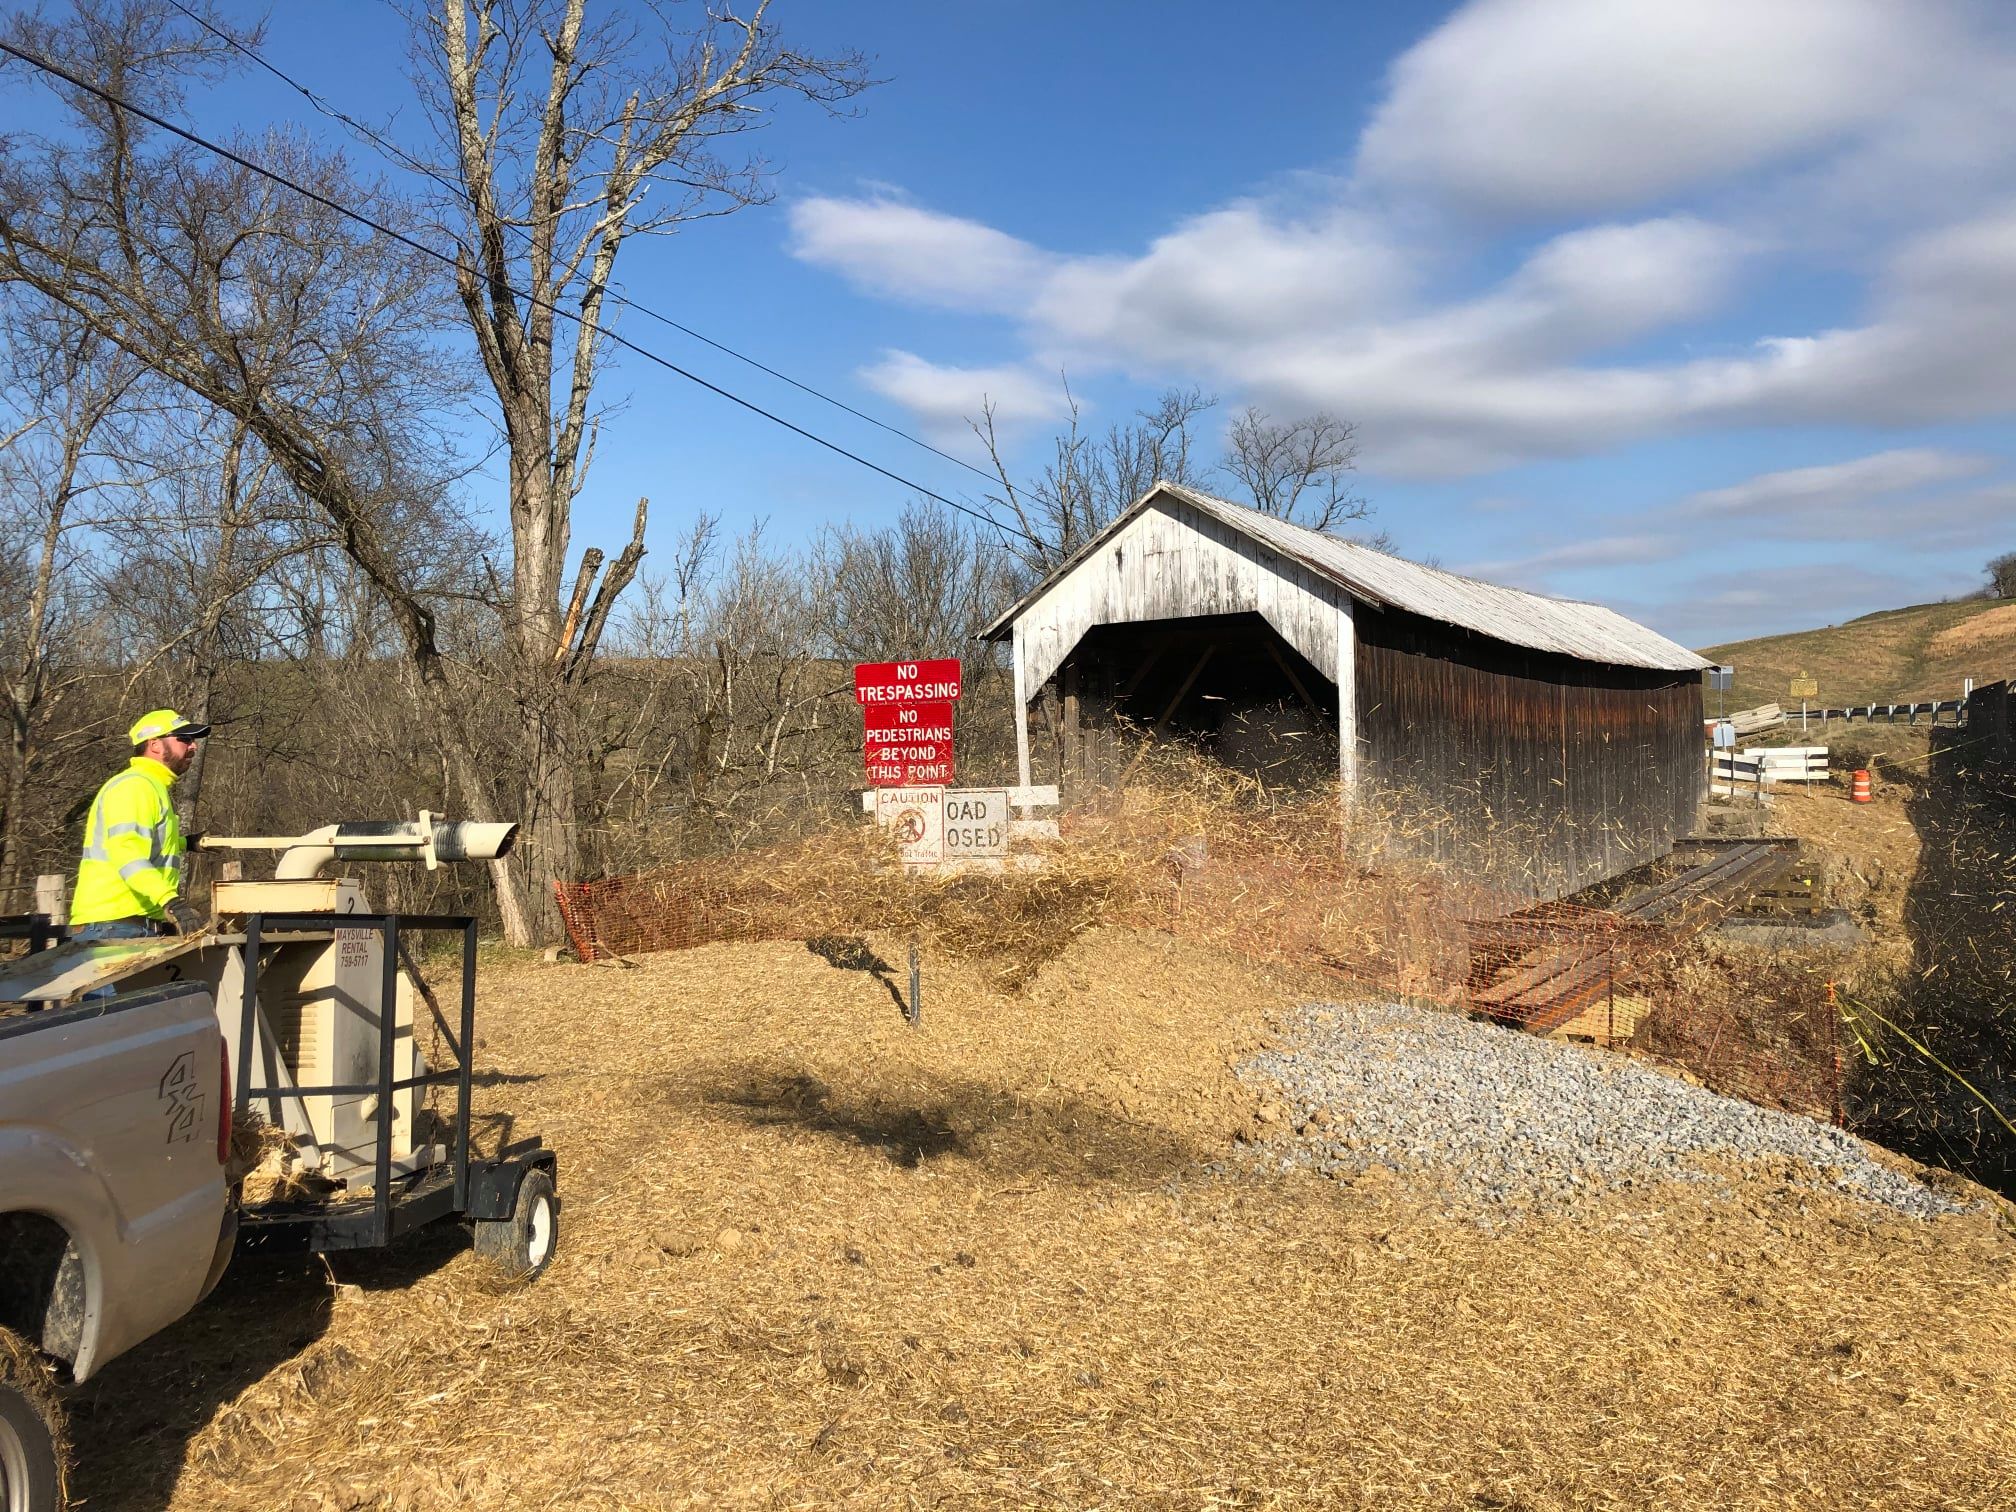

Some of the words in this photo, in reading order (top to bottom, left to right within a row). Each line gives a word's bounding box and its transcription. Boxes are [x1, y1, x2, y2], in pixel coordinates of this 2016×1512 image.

[897, 664, 918, 680] NO
[858, 682, 959, 702] TRESPASSING
[899, 709, 918, 723] NO
[866, 727, 952, 743] PEDESTRIANS
[881, 746, 936, 761] BEYOND
[870, 765, 901, 779] THIS
[907, 764, 948, 779] POINT
[881, 792, 939, 804] CAUTION
[947, 801, 987, 820] OAD
[947, 828, 1001, 848] OSED
[347, 896, 355, 914] 2
[336, 929, 374, 941] MAYSVILLE
[341, 942, 368, 954] RENTAL
[340, 955, 369, 967] 759-5717
[165, 963, 185, 982] 2
